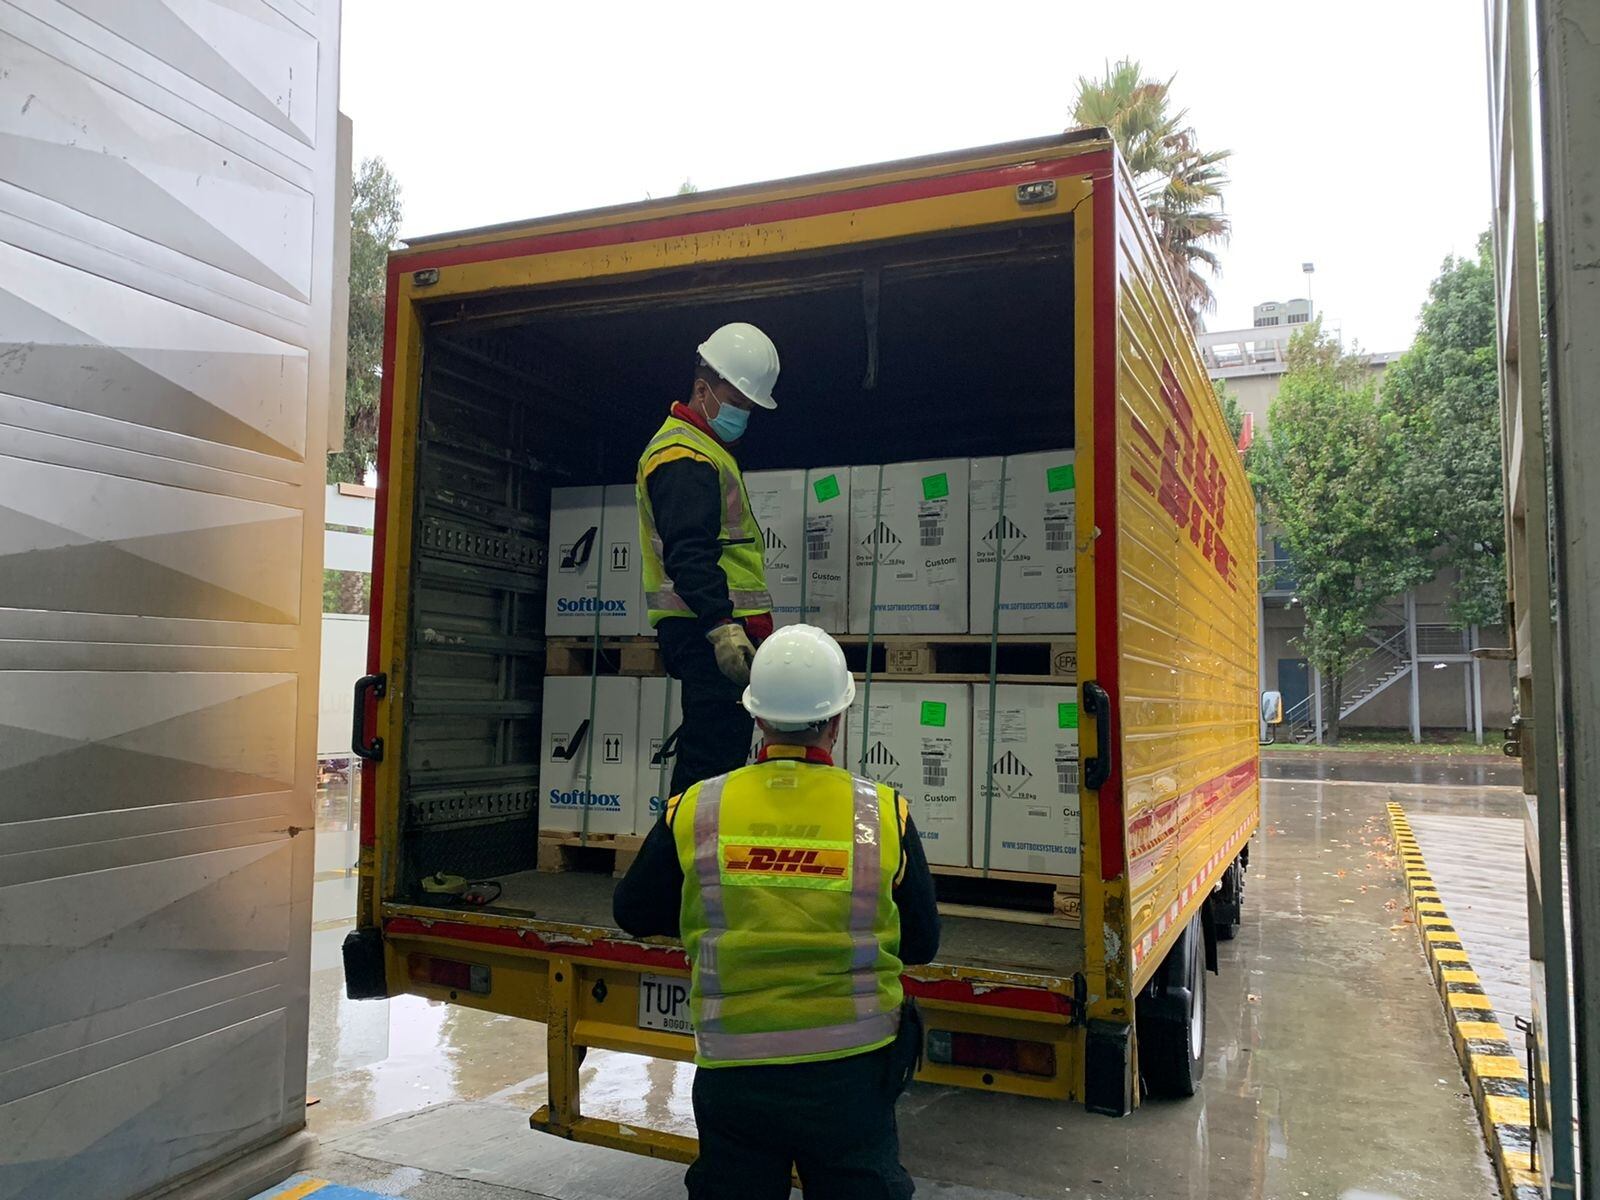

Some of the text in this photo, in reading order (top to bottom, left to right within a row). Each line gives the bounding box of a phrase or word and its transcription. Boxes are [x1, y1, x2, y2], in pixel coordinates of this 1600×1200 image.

[925, 557, 957, 568] Custom
[1055, 565, 1076, 575] Cust
[811, 571, 841, 582] Custom
[556, 596, 627, 613] Softbox
[1059, 656, 1077, 668] EPA
[549, 788, 621, 807] Softbox
[924, 793, 958, 803] Custom
[1062, 808, 1080, 817] Cus
[1002, 841, 1077, 854] WWW.SOFTBOXSYSTEMS.COM
[747, 848, 825, 873] DHL
[642, 980, 690, 1018] TUP
